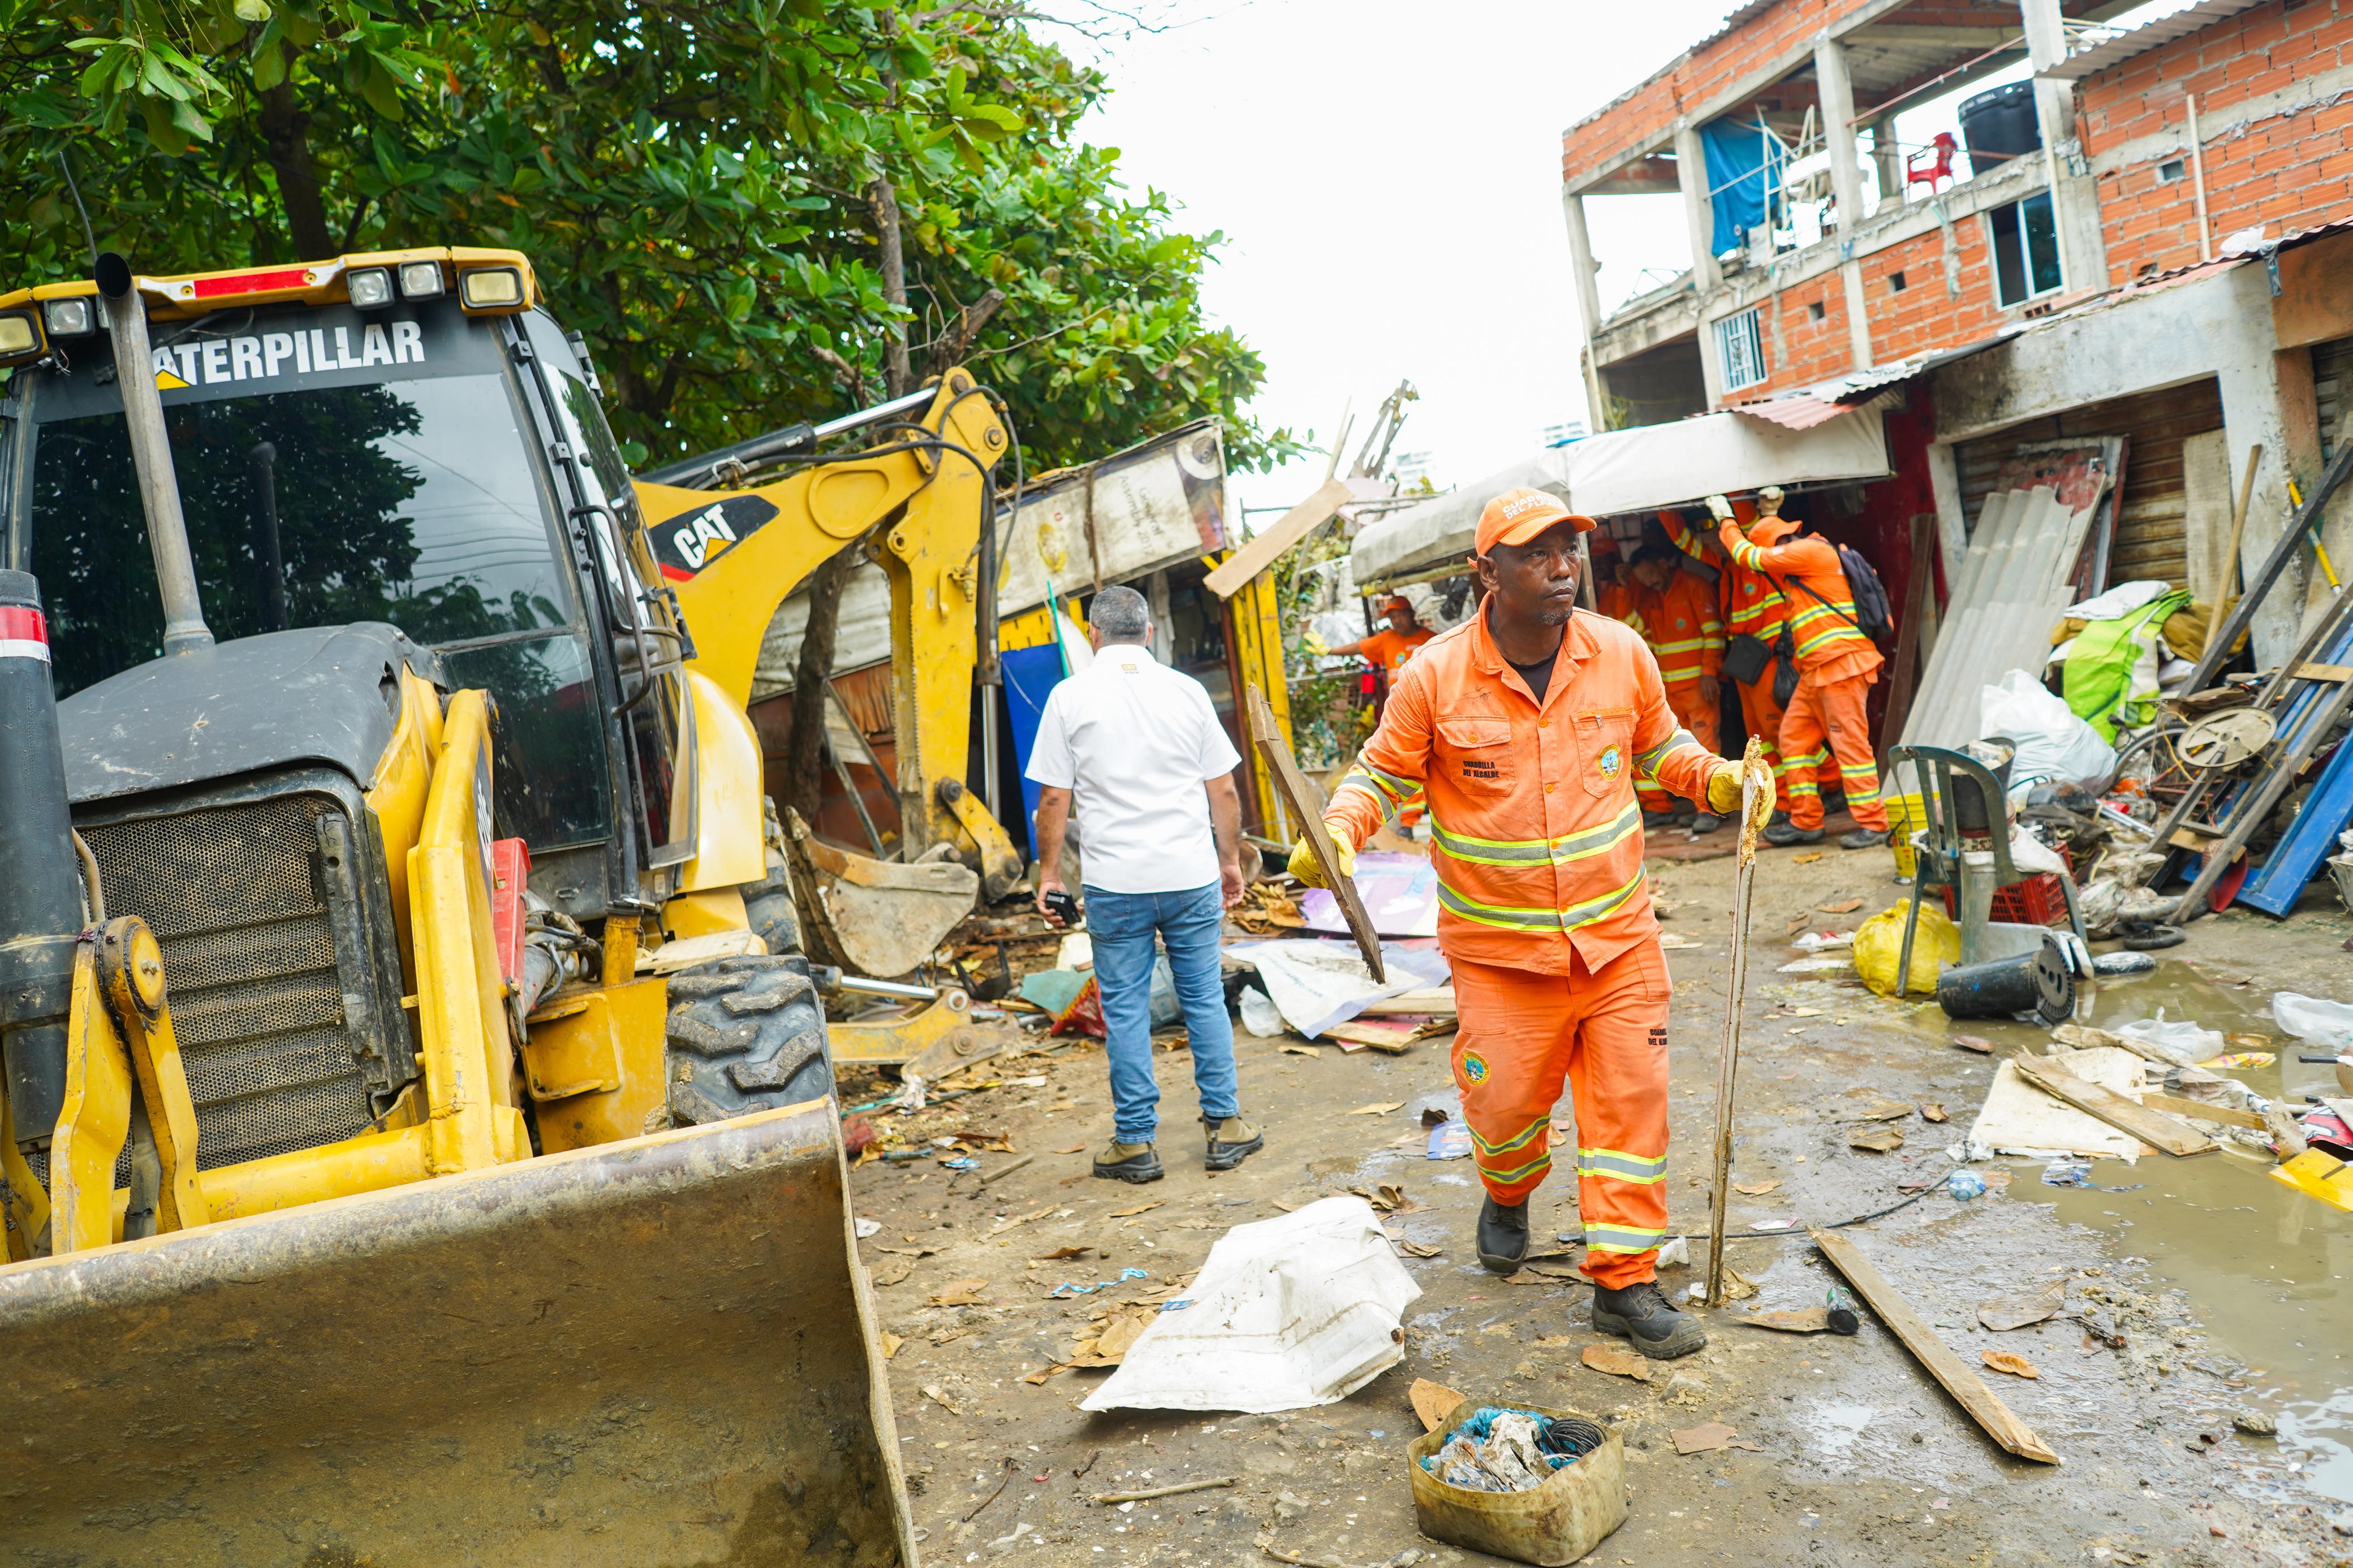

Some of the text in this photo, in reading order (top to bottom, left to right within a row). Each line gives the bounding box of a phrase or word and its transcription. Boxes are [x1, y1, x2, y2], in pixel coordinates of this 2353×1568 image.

[152, 321, 425, 387] ATERPILLAR
[1505, 506, 1526, 520] DEL
[674, 503, 737, 569] CAT
[1463, 761, 1495, 769] CUADRILLA
